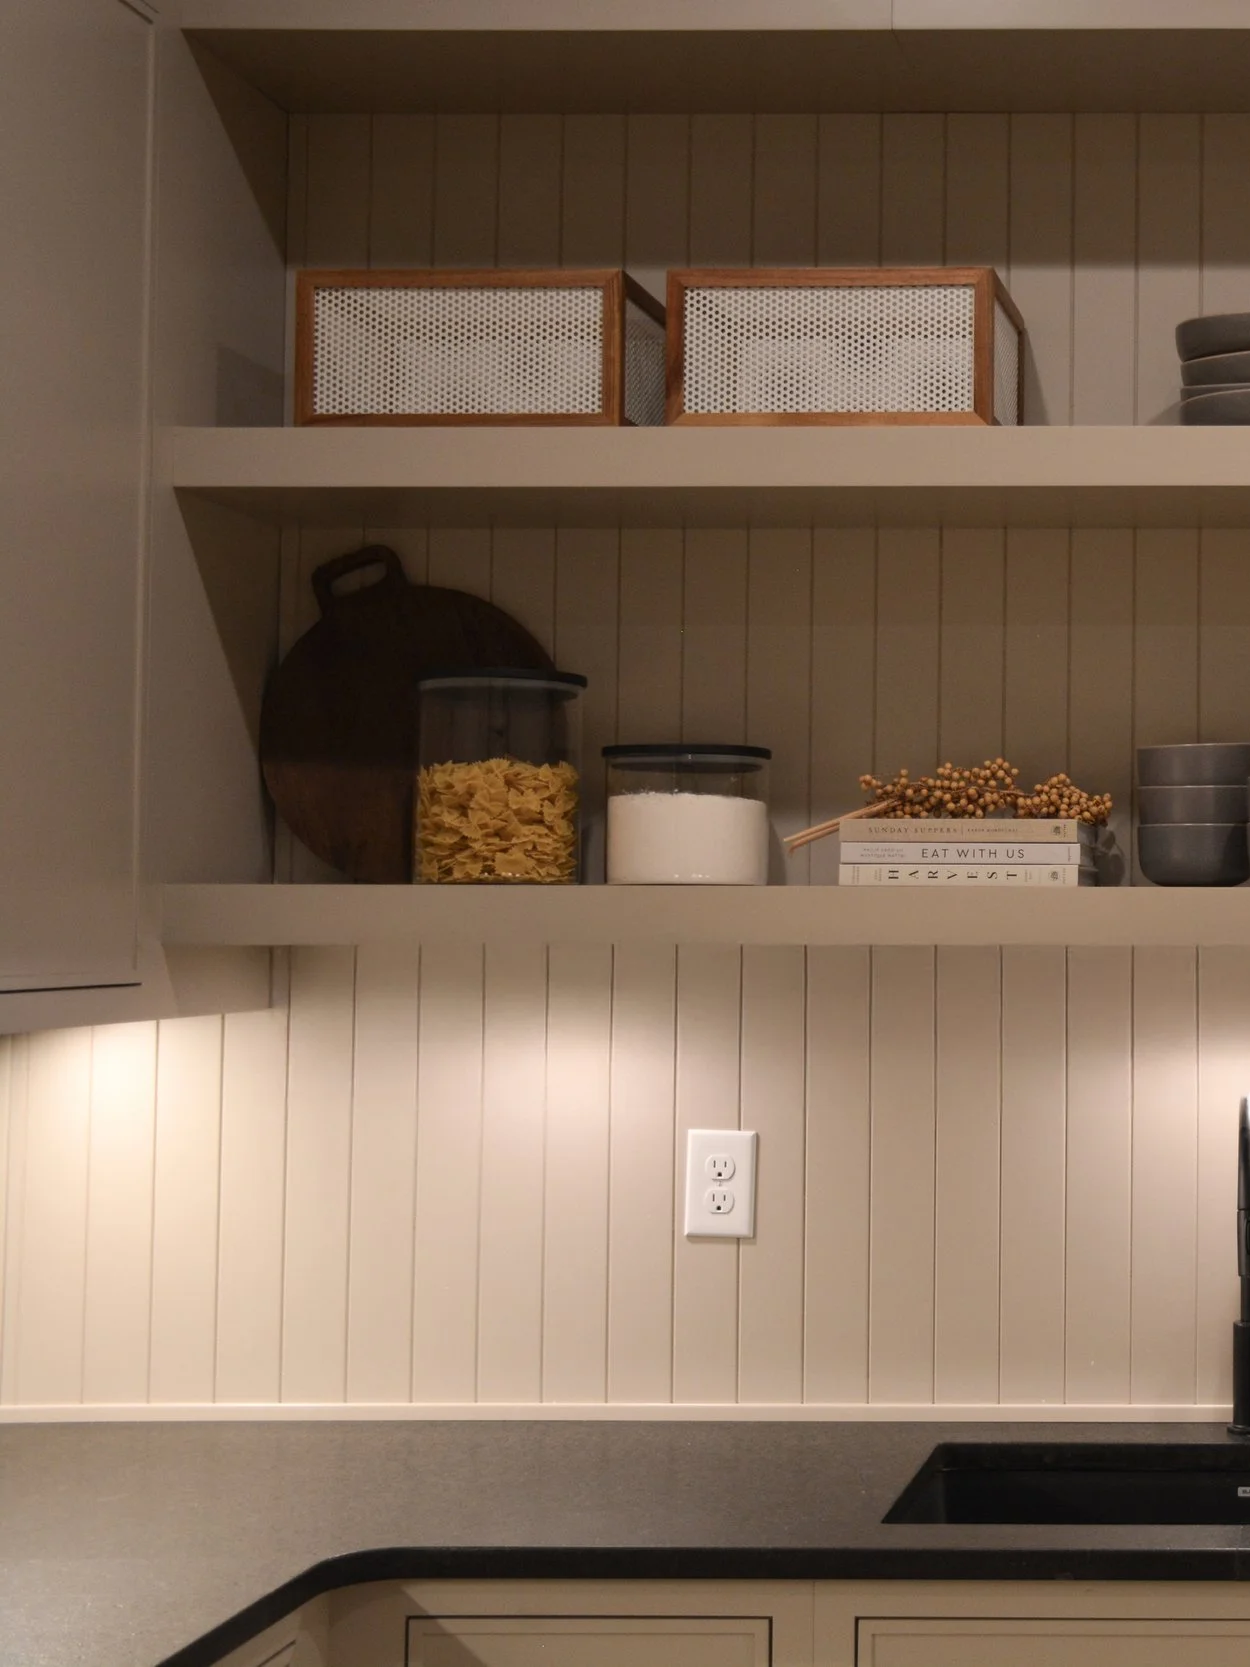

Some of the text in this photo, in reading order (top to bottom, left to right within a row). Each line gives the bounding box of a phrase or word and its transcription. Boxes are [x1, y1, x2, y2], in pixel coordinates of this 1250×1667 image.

[921, 848, 1025, 859] EAT WITH US
[888, 869, 1018, 880] HARVEST
